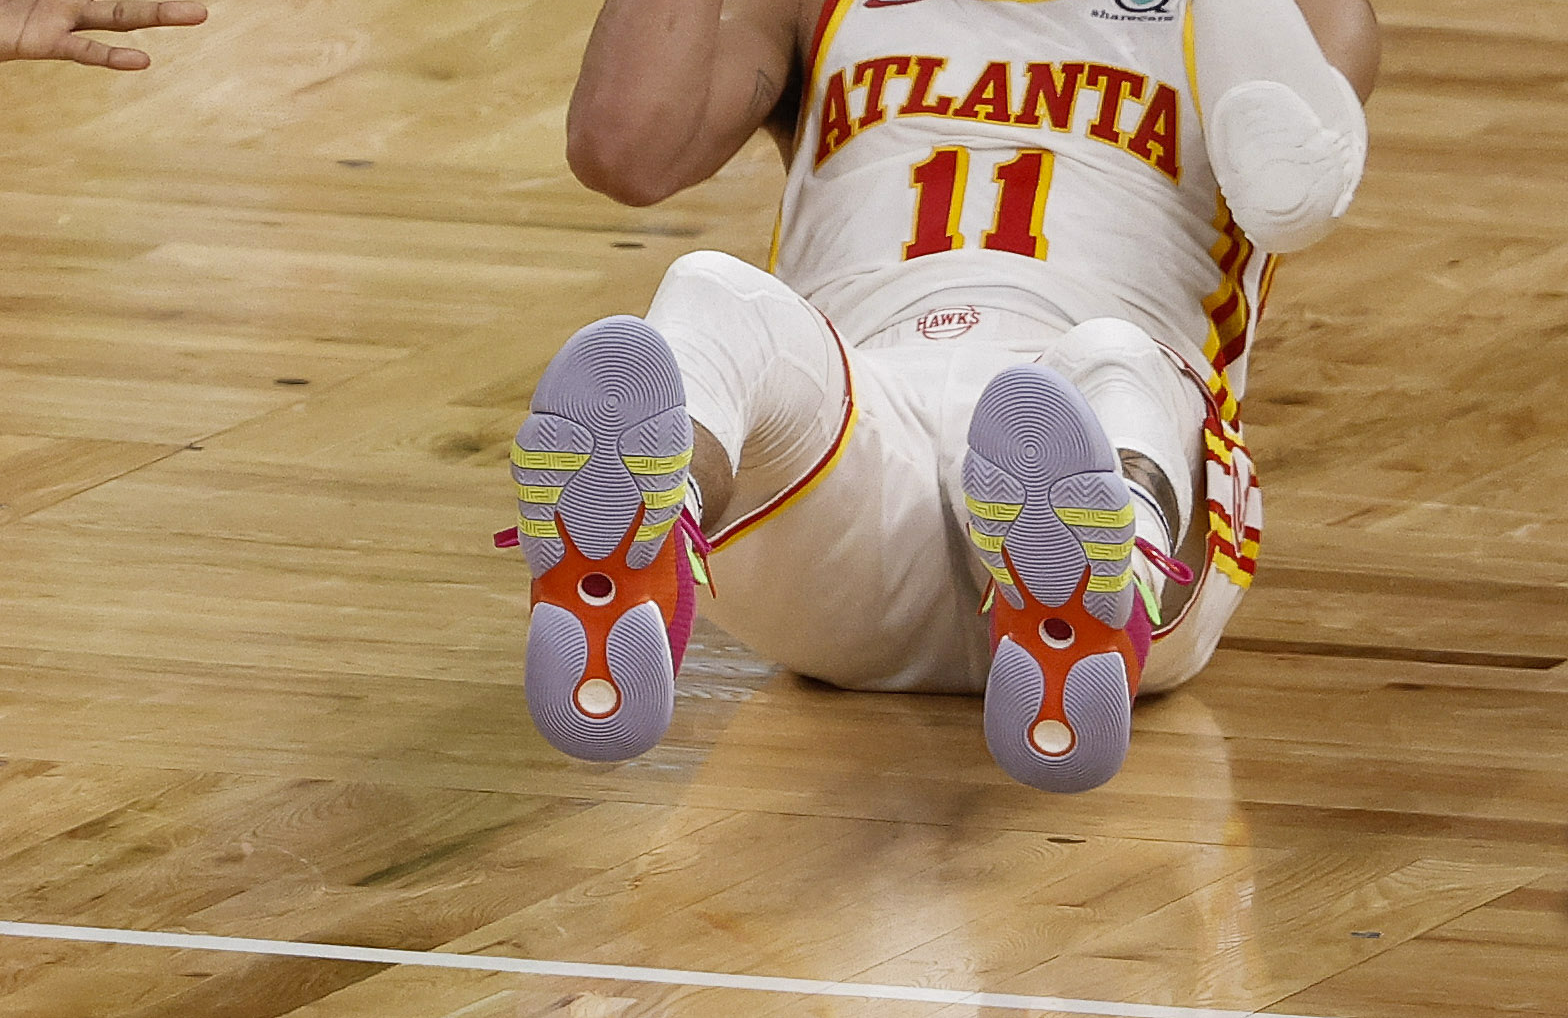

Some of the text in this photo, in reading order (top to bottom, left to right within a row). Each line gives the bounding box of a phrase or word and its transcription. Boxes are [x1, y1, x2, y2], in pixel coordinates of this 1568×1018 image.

[813, 54, 1181, 187] ATLANTA
[901, 144, 1054, 261] 11
[915, 311, 981, 332] HAWKS
